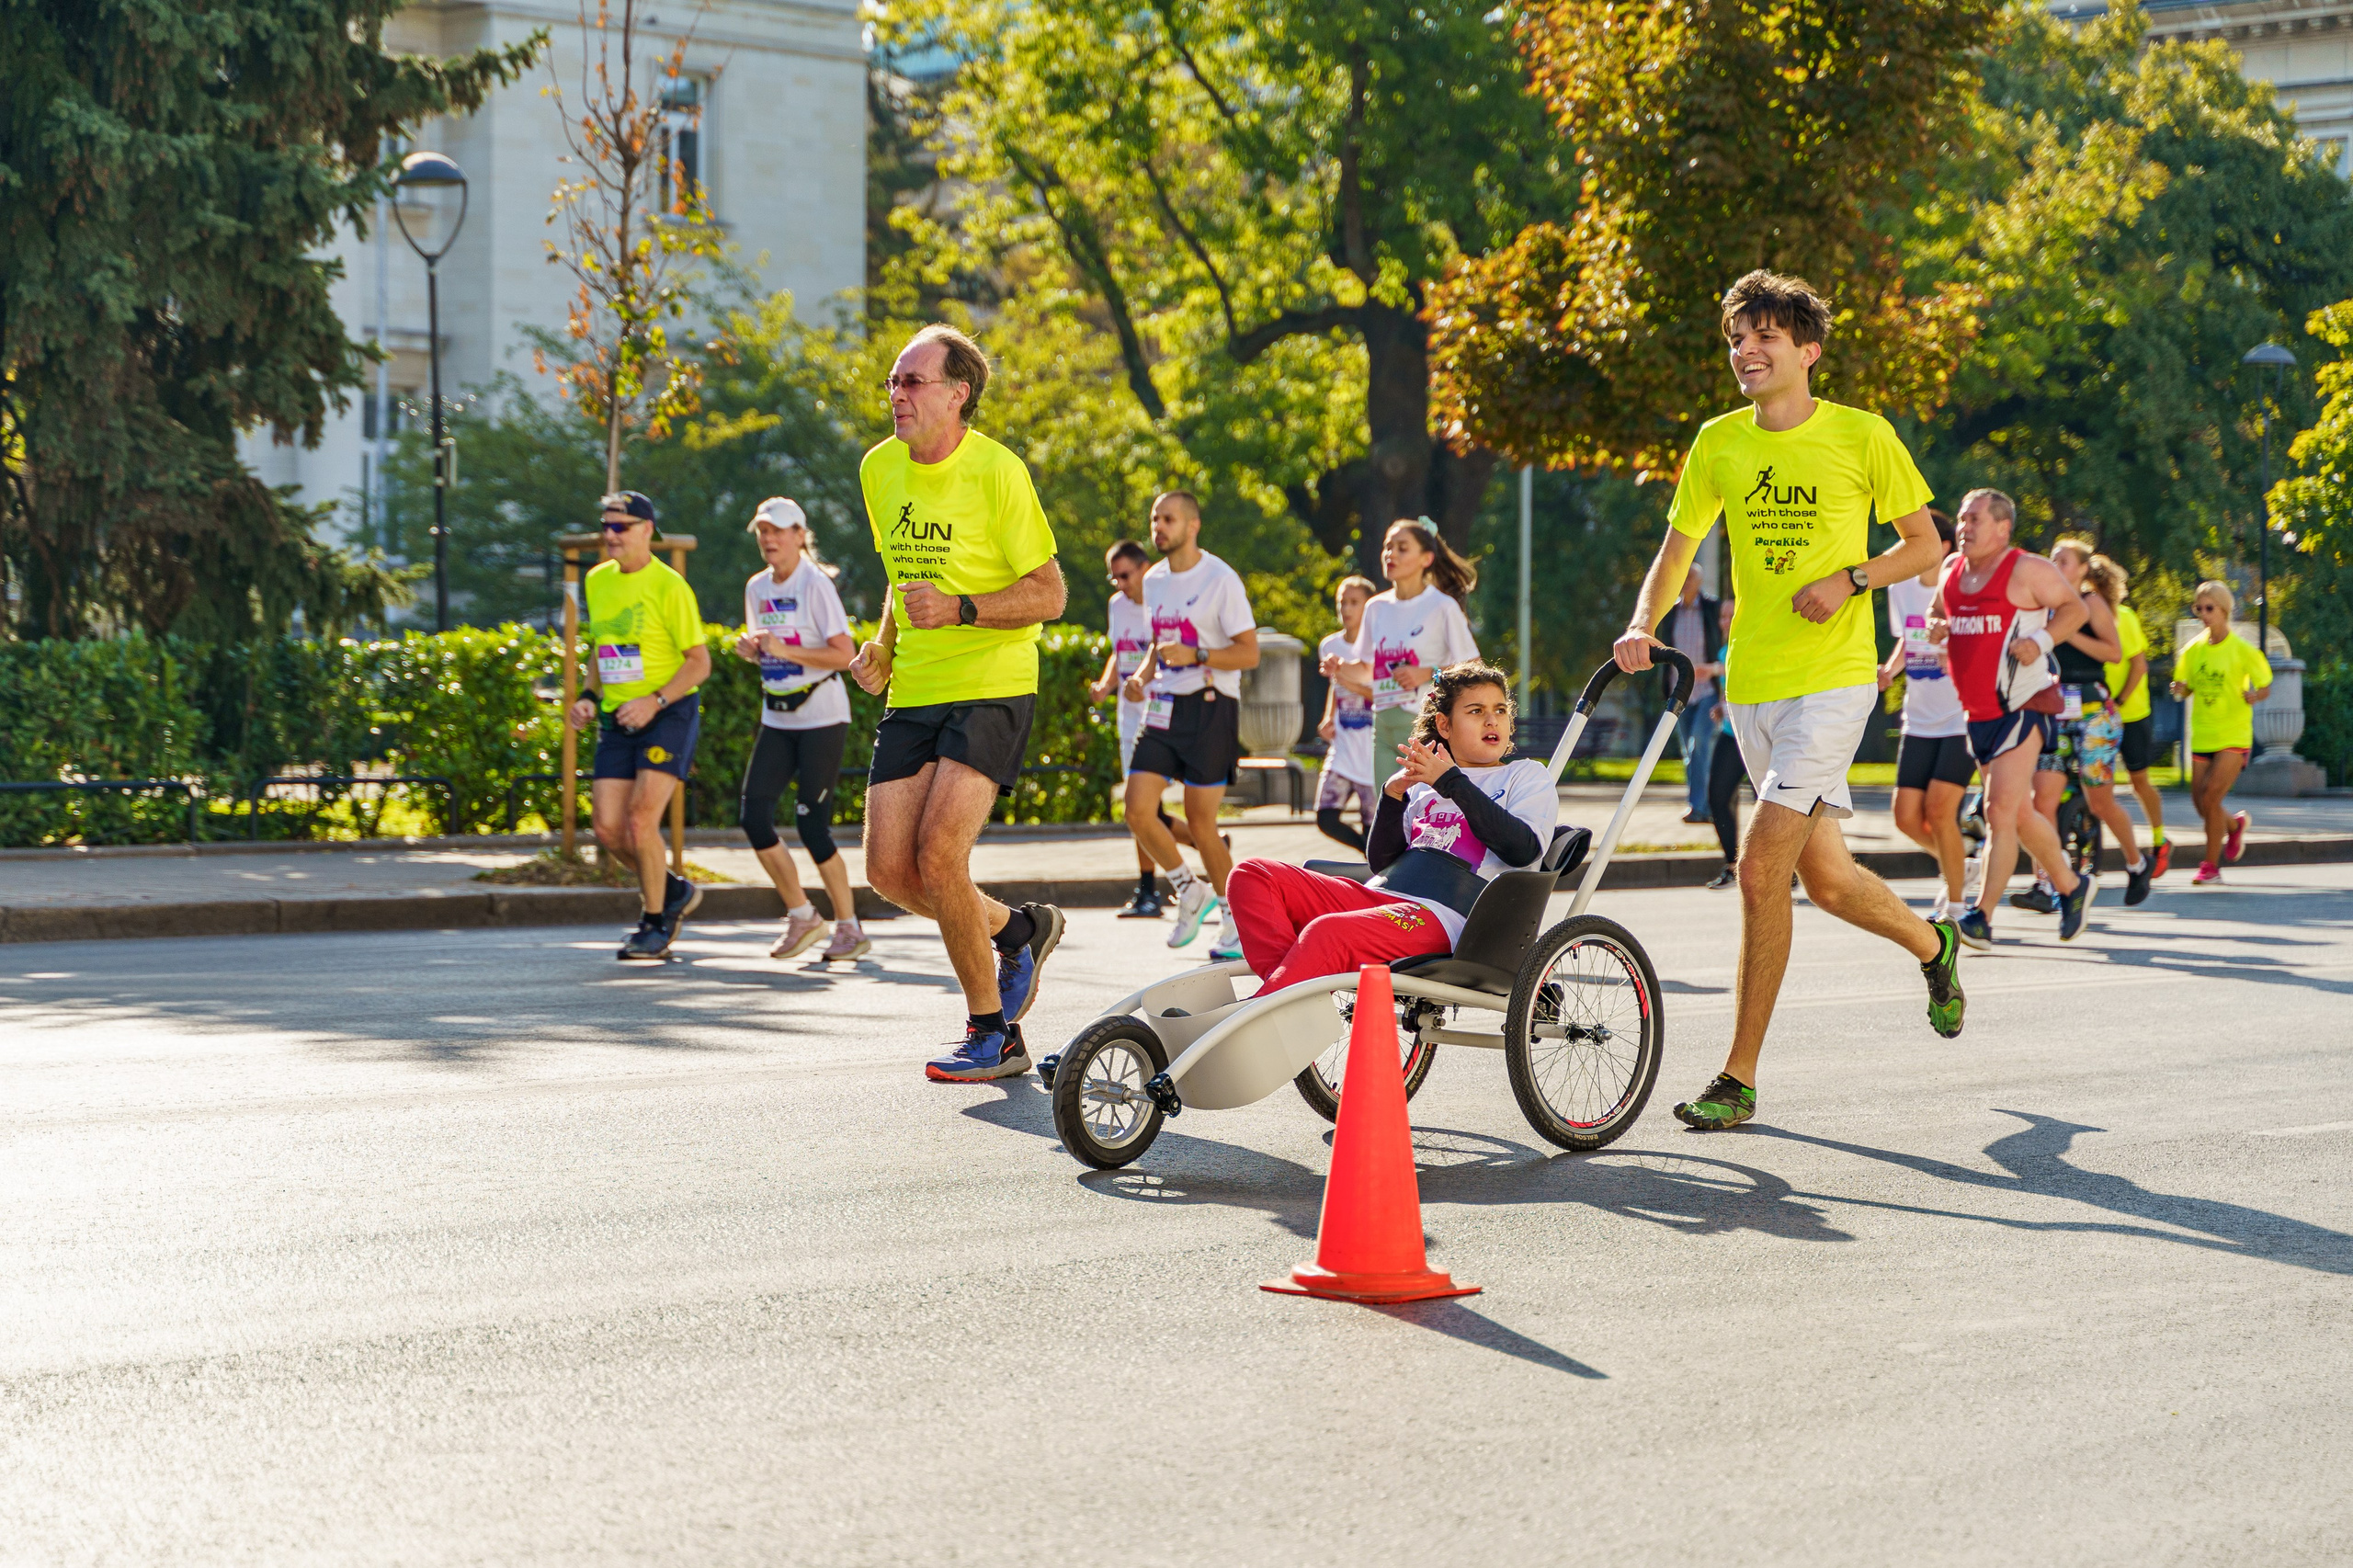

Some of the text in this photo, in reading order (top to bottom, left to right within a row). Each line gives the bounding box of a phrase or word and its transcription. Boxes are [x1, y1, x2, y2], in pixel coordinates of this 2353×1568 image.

[1746, 508, 1817, 517] with those
[1751, 520, 1814, 529] who can't
[1755, 537, 1810, 546] ParaKids
[890, 542, 950, 553] with those
[892, 555, 947, 565] who can't
[1415, 1051, 1431, 1081] Country
